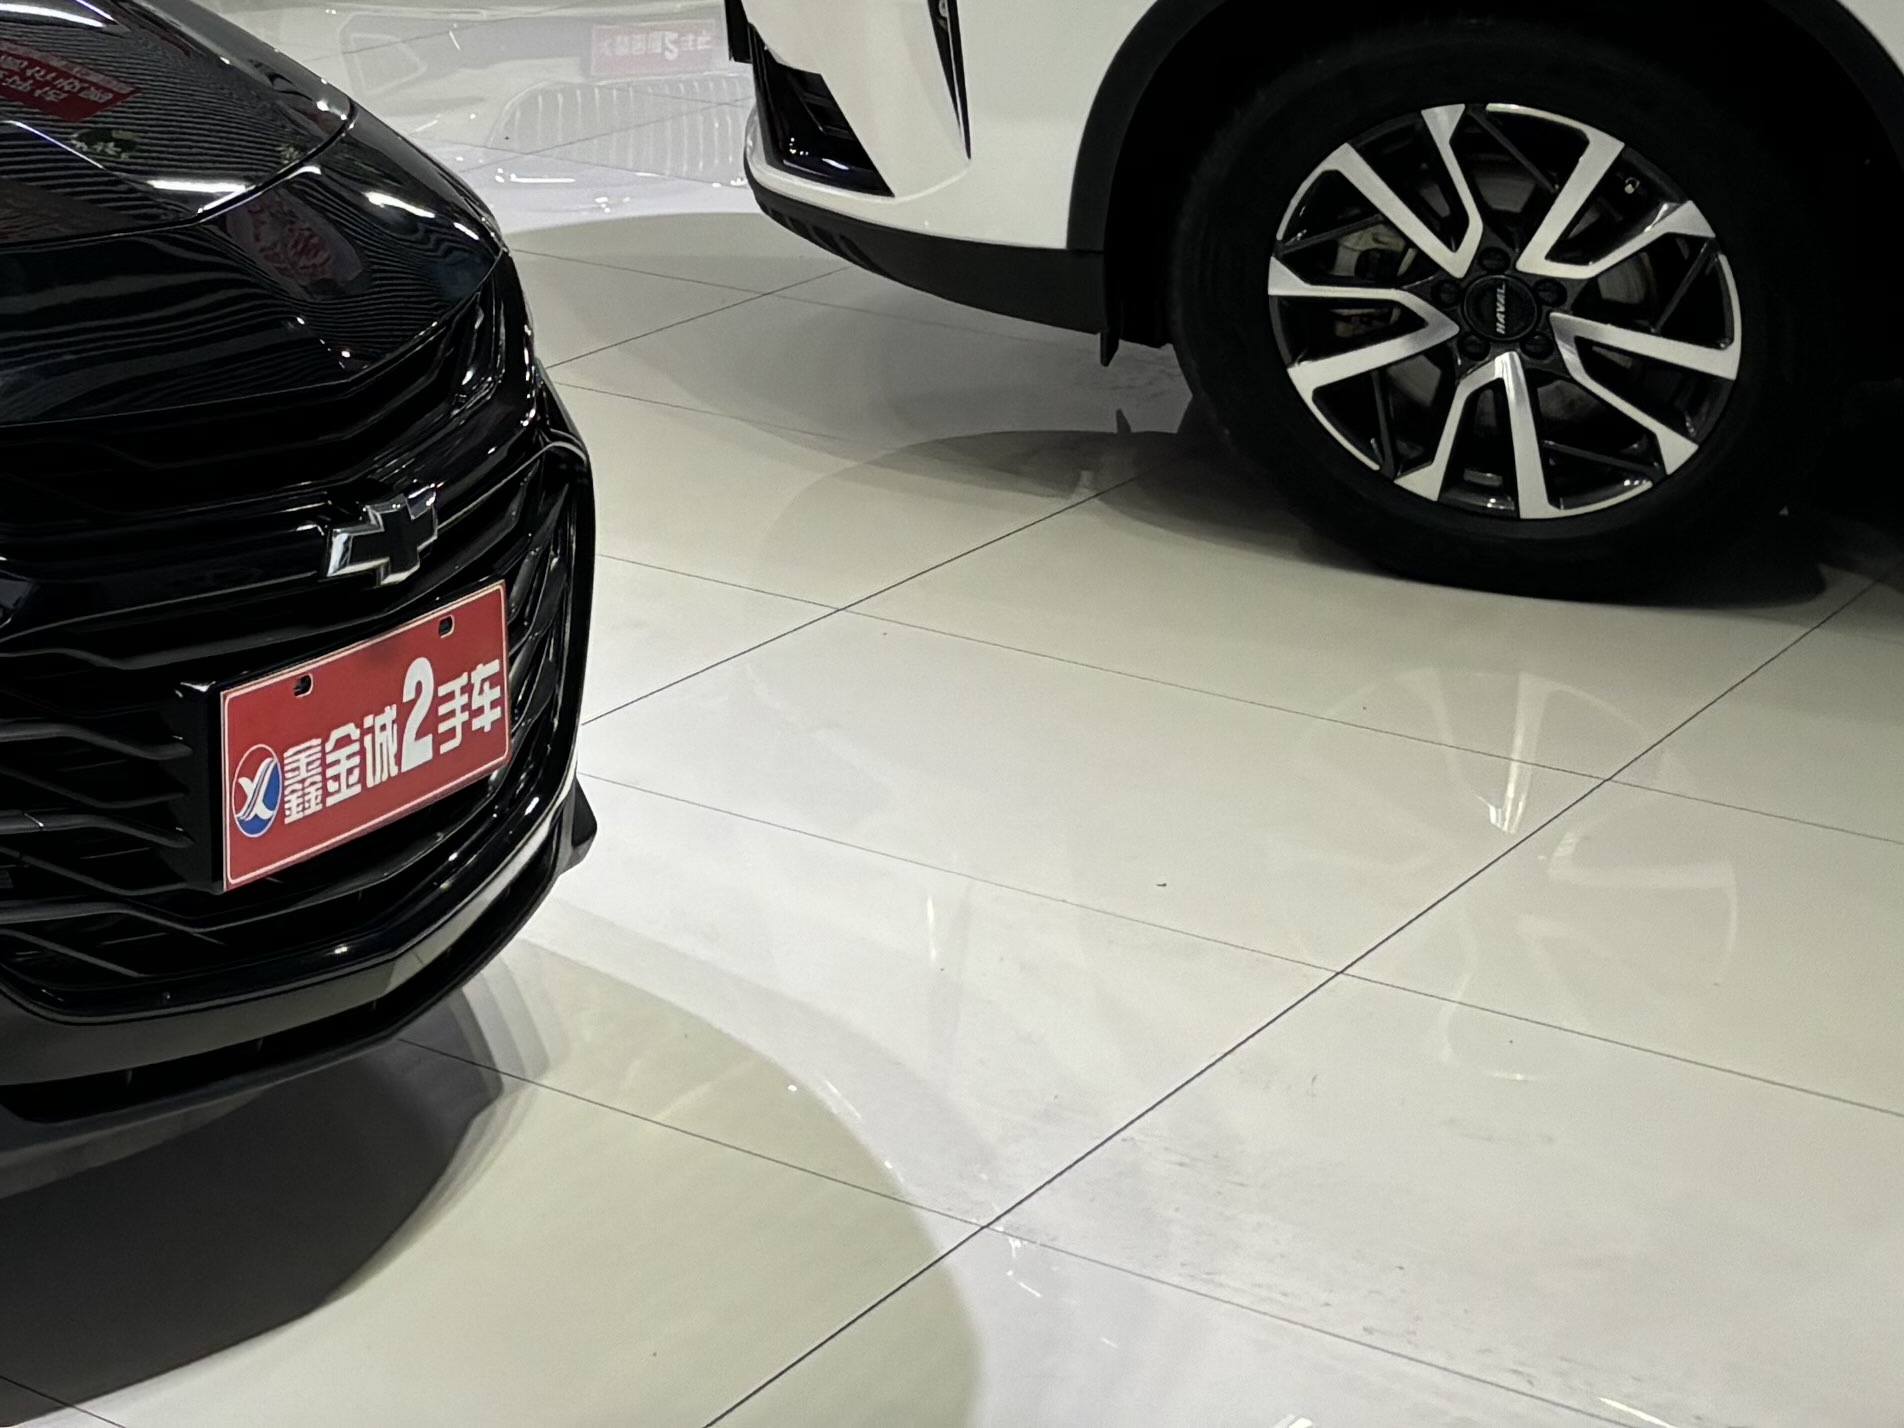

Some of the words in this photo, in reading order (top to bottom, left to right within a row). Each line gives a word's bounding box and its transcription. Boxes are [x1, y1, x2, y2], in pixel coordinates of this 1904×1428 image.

[1495, 281, 1506, 335] HAVAL
[283, 656, 502, 824] 鑫金诚2手车
